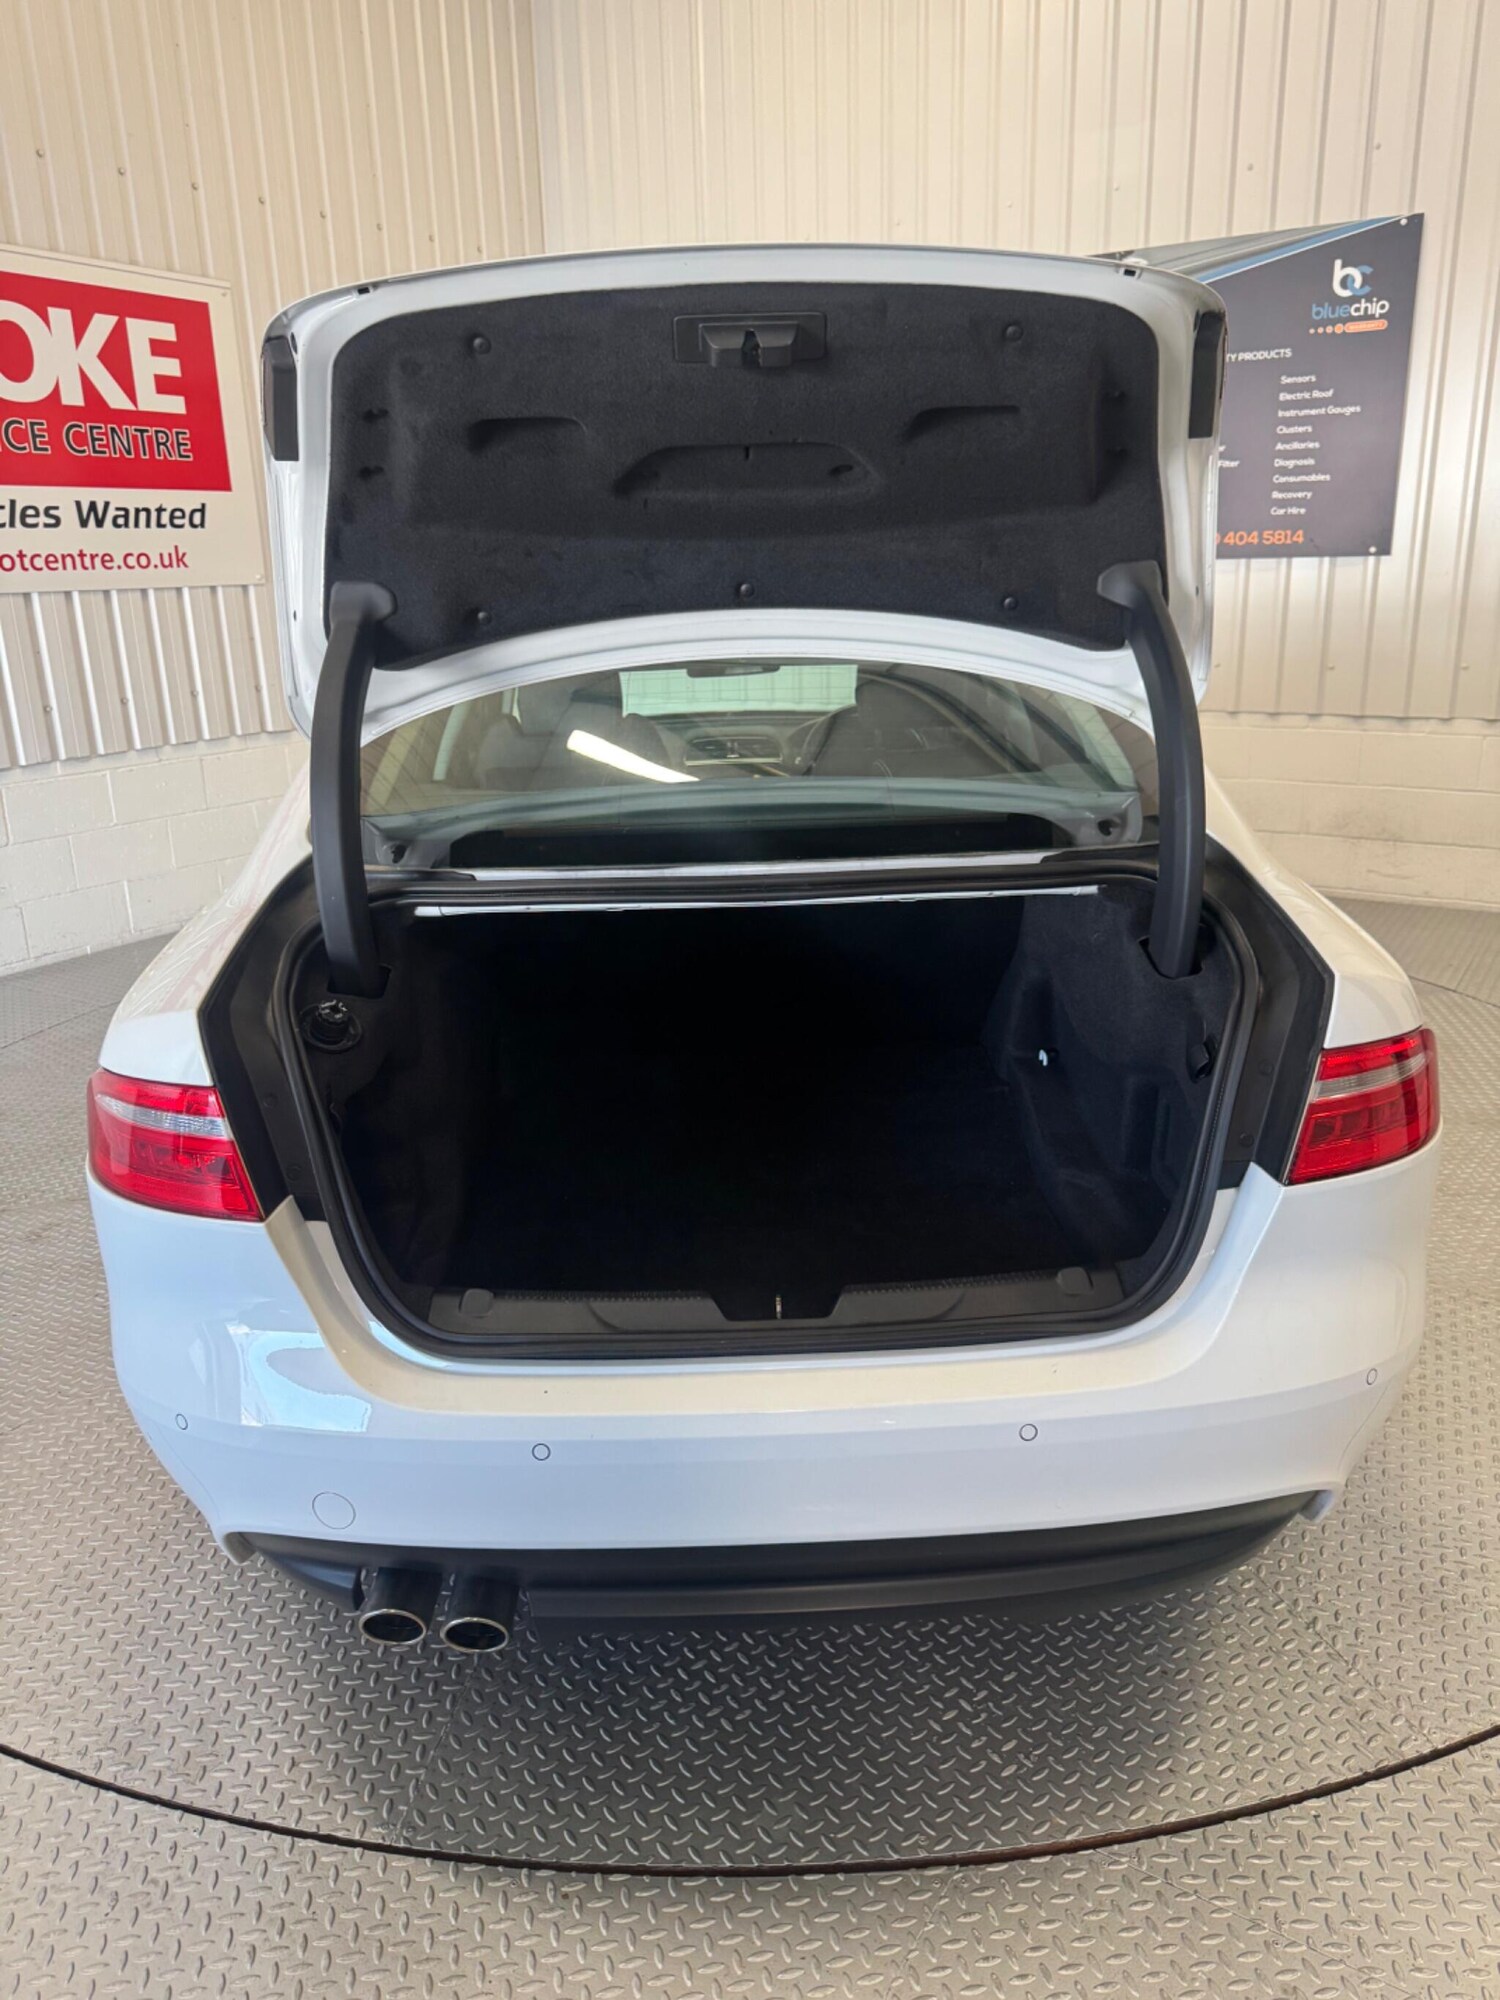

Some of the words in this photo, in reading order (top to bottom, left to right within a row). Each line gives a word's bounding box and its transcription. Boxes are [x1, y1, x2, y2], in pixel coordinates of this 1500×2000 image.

[1312, 297, 1390, 319] bluechip
[1238, 348, 1292, 361] PRODUCTS
[1280, 375, 1316, 384] Sensors
[1279, 391, 1311, 401] Electric
[1312, 388, 1334, 399] Roof
[1278, 409, 1326, 417] Instrument
[1327, 405, 1361, 416] Gauges
[1276, 425, 1313, 434] Clusters
[63, 422, 193, 461] CENTRE
[1275, 441, 1321, 450] Ancillaries
[1274, 457, 1316, 469] Diagnosis
[1272, 473, 1331, 483] Consumables
[1271, 491, 1313, 500] Recovery
[74, 500, 206, 529] Wanted
[1270, 506, 1287, 515] Car
[1287, 506, 1307, 515] Hire
[1223, 531, 1258, 546] 404
[1262, 529, 1304, 545] 5814
[0, 545, 189, 572] otcentre.co.uk
